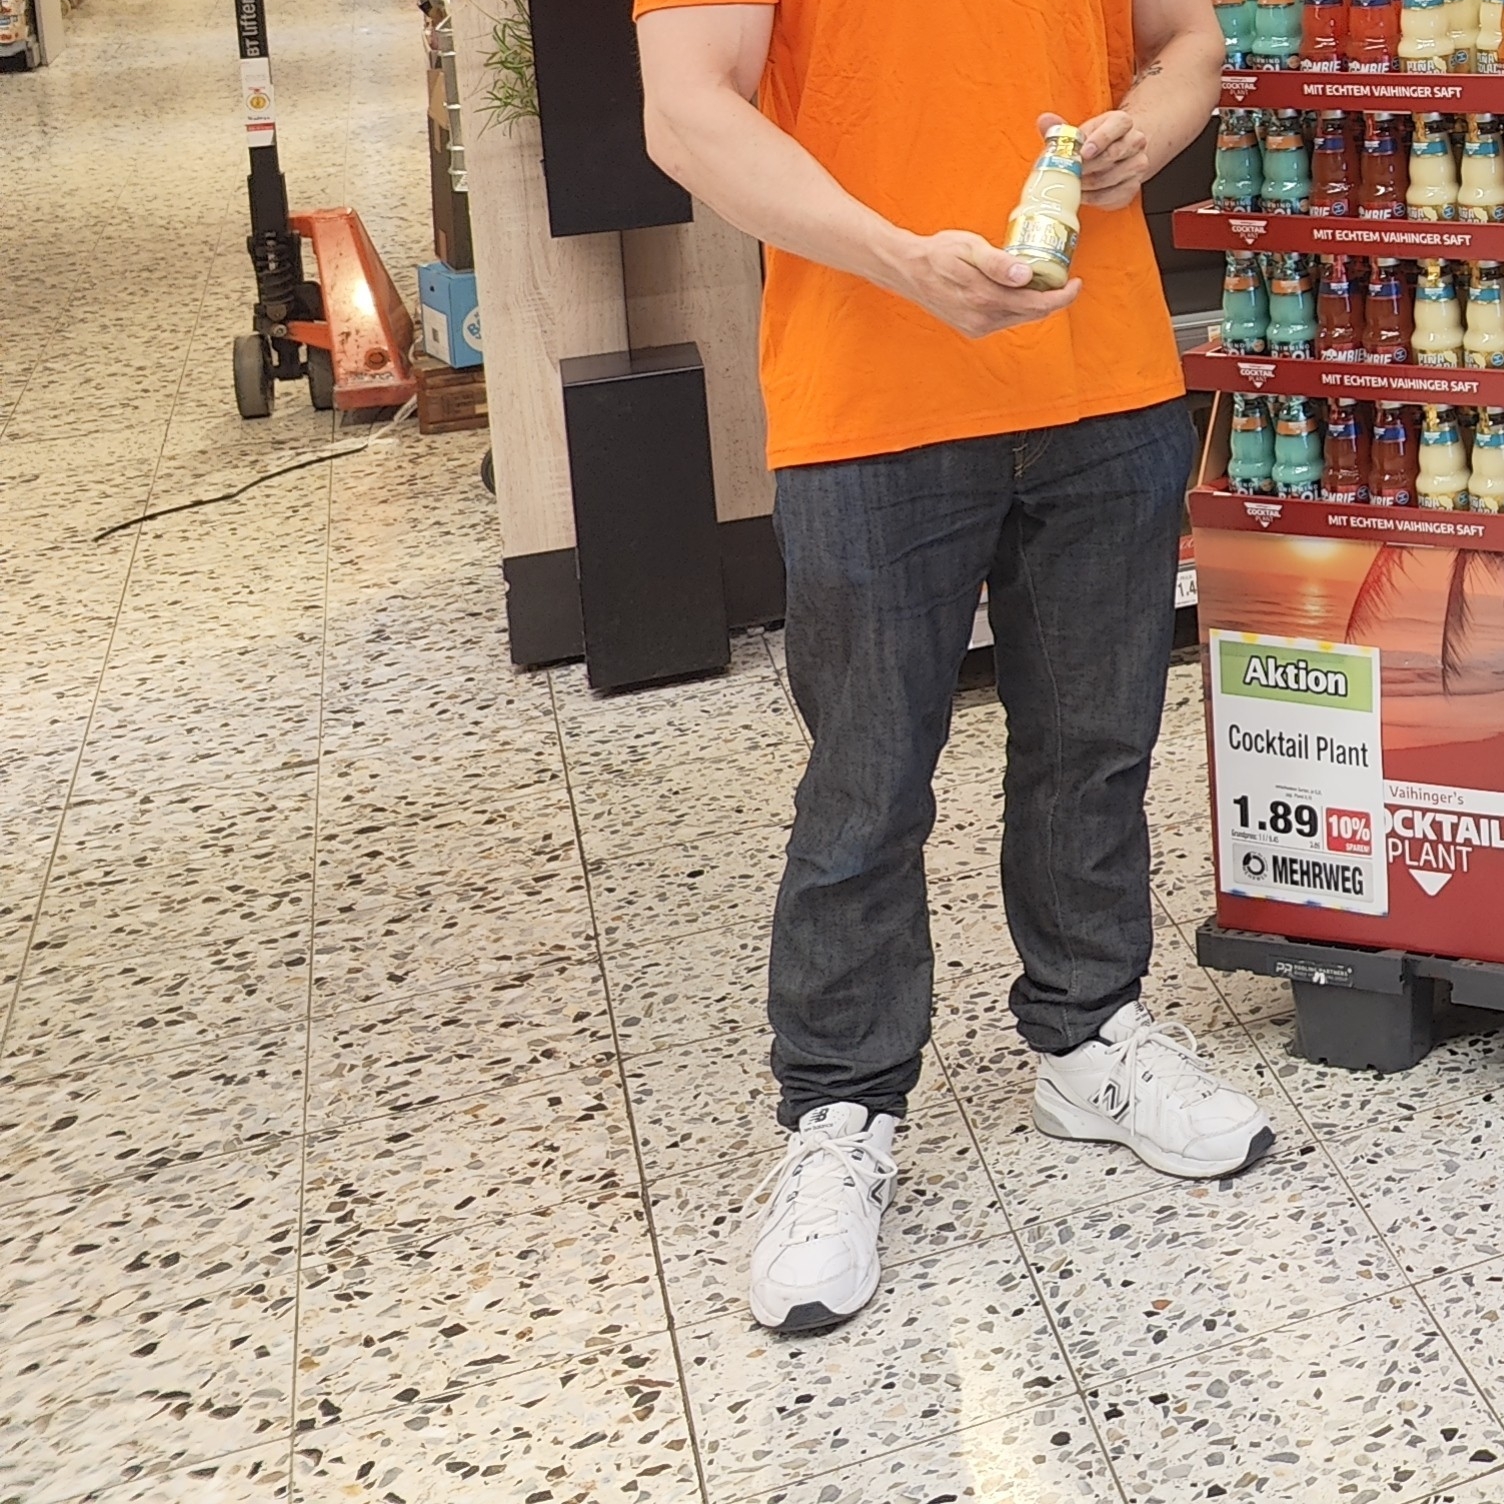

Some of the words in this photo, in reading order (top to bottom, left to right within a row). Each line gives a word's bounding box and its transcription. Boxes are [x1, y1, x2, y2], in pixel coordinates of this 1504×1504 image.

[245, 39, 259, 57] BT
[1303, 83, 1323, 95] MIT
[1327, 84, 1370, 96] ECHTEM
[1371, 85, 1433, 98] VAIHINGER
[1434, 86, 1463, 99] SAFT
[1312, 229, 1334, 240] MIT
[1335, 229, 1380, 242] ECHTEM
[1381, 231, 1442, 245] VAIHINGER
[1442, 233, 1472, 246] SAFT
[1321, 373, 1342, 385] MIT
[1343, 374, 1389, 388] ECHTEM
[1389, 376, 1450, 391] VAIHINGER
[1450, 380, 1479, 393] SAFT
[1328, 514, 1348, 526] MIT
[1350, 516, 1395, 530] ECHTEM
[1395, 518, 1455, 535] VAIHINGER
[1456, 522, 1486, 537] SAFT
[1243, 655, 1348, 698] Aktion
[1228, 723, 1309, 761] Cocktail
[1316, 735, 1370, 768] Plant
[1389, 784, 1465, 807] Vaihinger's
[1232, 794, 1319, 839] 1.89
[1328, 813, 1371, 842] 10%
[1388, 838, 1473, 873] PLANT
[1271, 854, 1365, 896] MEHRWEG
